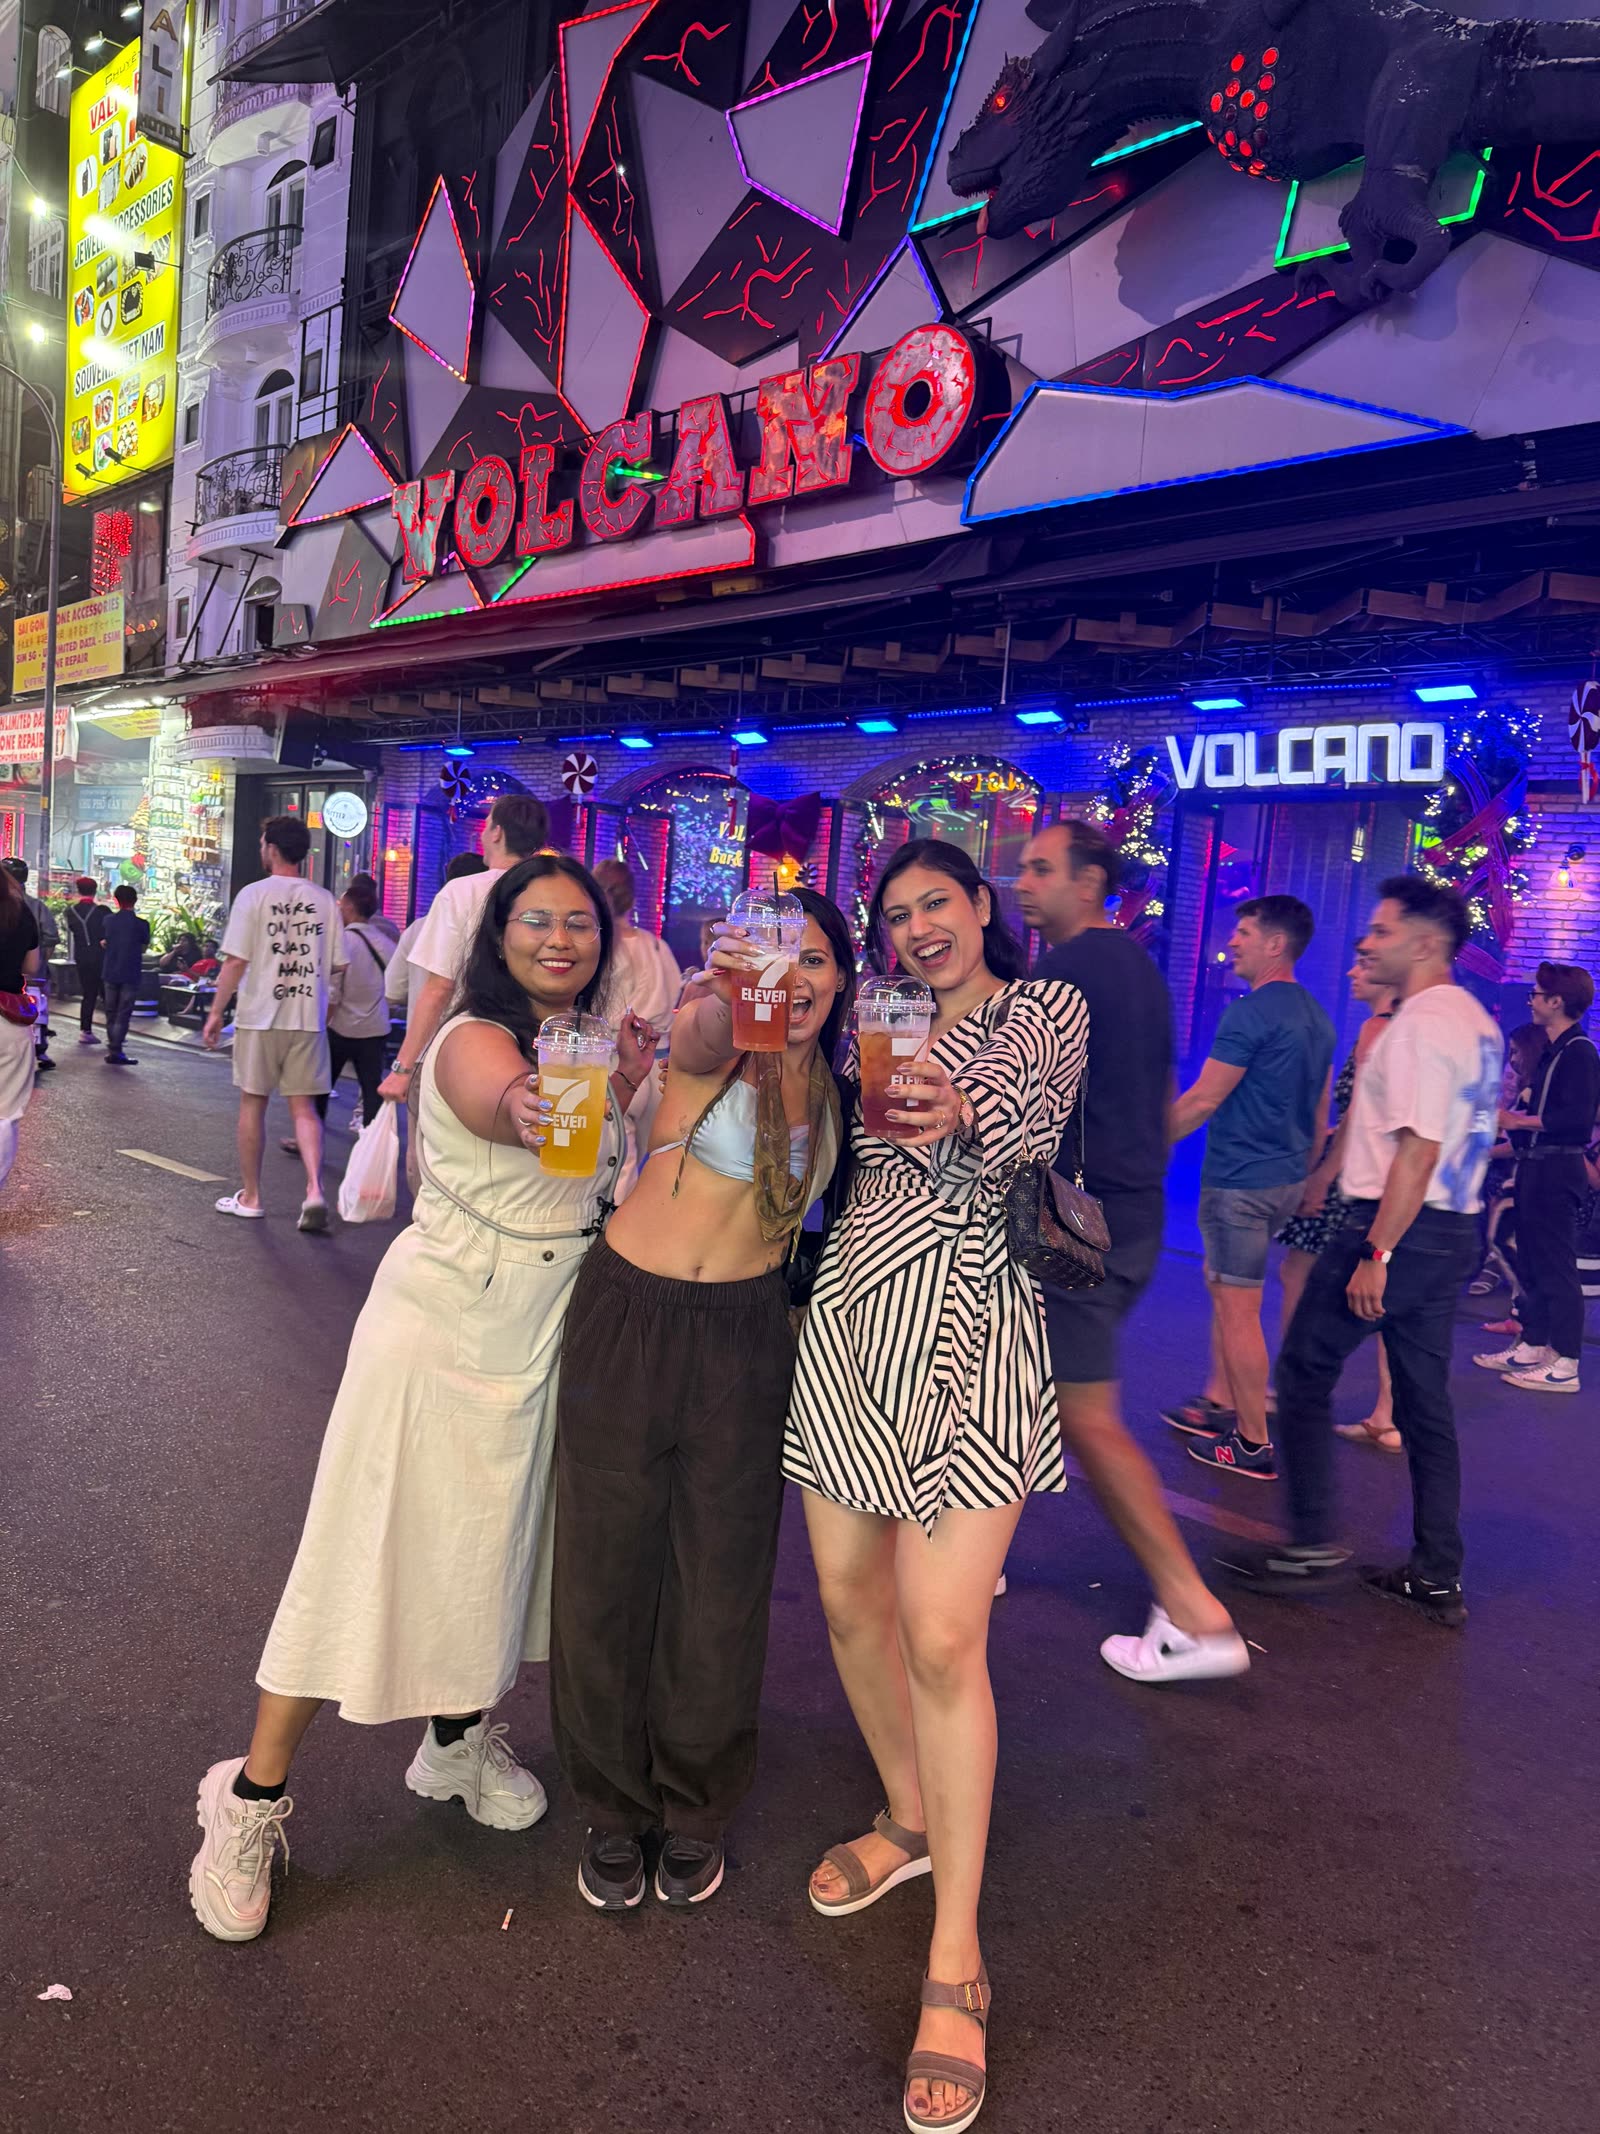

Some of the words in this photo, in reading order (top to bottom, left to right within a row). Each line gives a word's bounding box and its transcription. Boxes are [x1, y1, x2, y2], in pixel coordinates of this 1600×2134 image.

[141, 324, 164, 359] NAM
[393, 322, 978, 584] VOLCANO
[71, 598, 119, 622] ACCESSORIES
[79, 636, 97, 650] DATA
[65, 653, 89, 667] REPAIR
[1165, 722, 1445, 790] VOLCANO
[291, 921, 324, 937] THE
